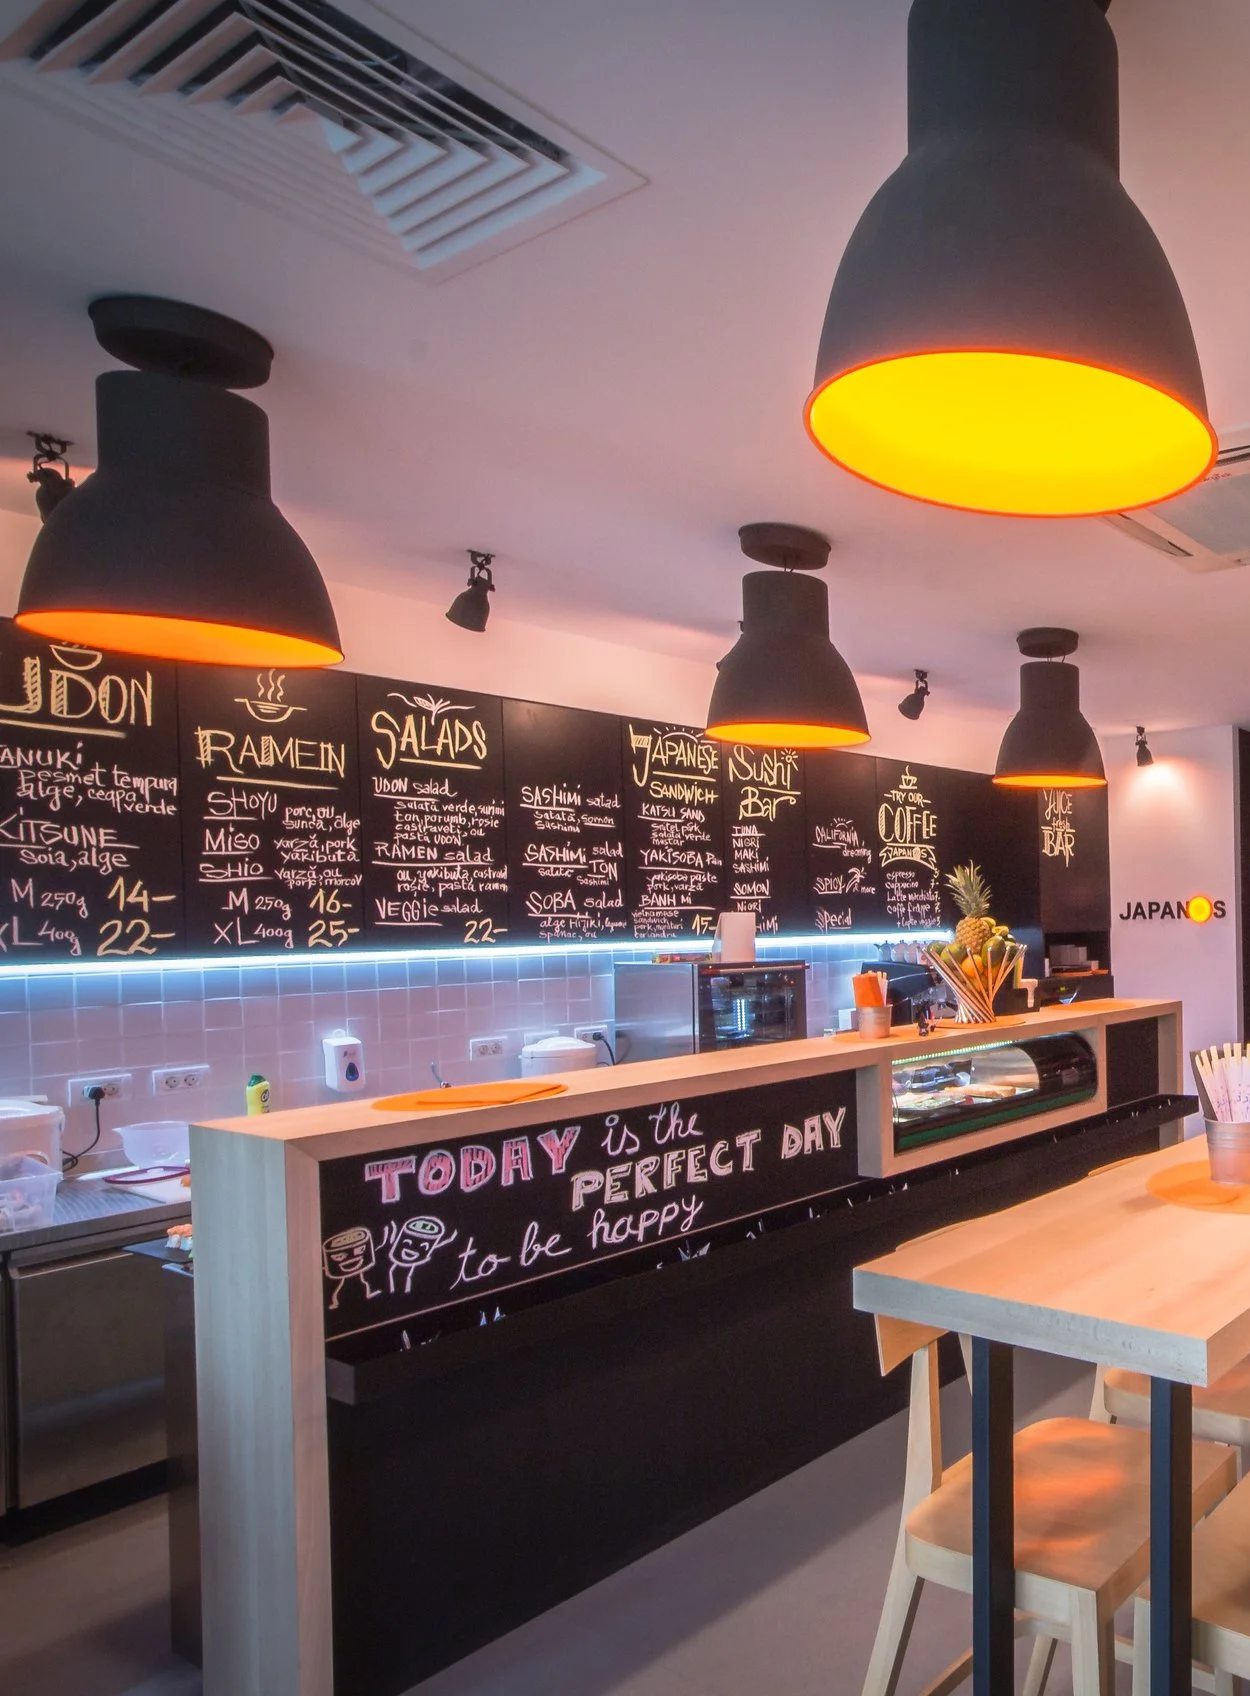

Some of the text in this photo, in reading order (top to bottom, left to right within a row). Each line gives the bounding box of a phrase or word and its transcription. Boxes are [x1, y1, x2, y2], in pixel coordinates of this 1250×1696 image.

[0, 741, 83, 770] ANUKi
[194, 726, 345, 778] RAMEN
[371, 710, 487, 770] SALADS
[629, 723, 718, 787] JAPANESE
[729, 744, 794, 789] Sushi
[372, 777, 408, 793] UDON
[642, 803, 705, 823] KATSU SAND
[739, 786, 796, 822] Bar
[1043, 788, 1073, 820] JUICE
[878, 803, 937, 844] COFFEE
[374, 841, 437, 861] RAMEN
[1042, 831, 1075, 867] BAR
[589, 859, 618, 882] TON
[11, 878, 34, 908] M
[41, 892, 88, 919] 250g
[525, 889, 576, 914] SOBA
[639, 893, 676, 907] BANH
[733, 879, 769, 896] SOMON
[222, 888, 248, 914] M
[255, 896, 291, 920] 250g
[1119, 896, 1226, 924] JAPANOS
[213, 917, 259, 945] XL
[254, 923, 294, 948] 400g
[364, 1102, 704, 1204] TODAY is the
[570, 1106, 847, 1213] PERFECT DAY
[450, 1194, 704, 1290] to be happy
